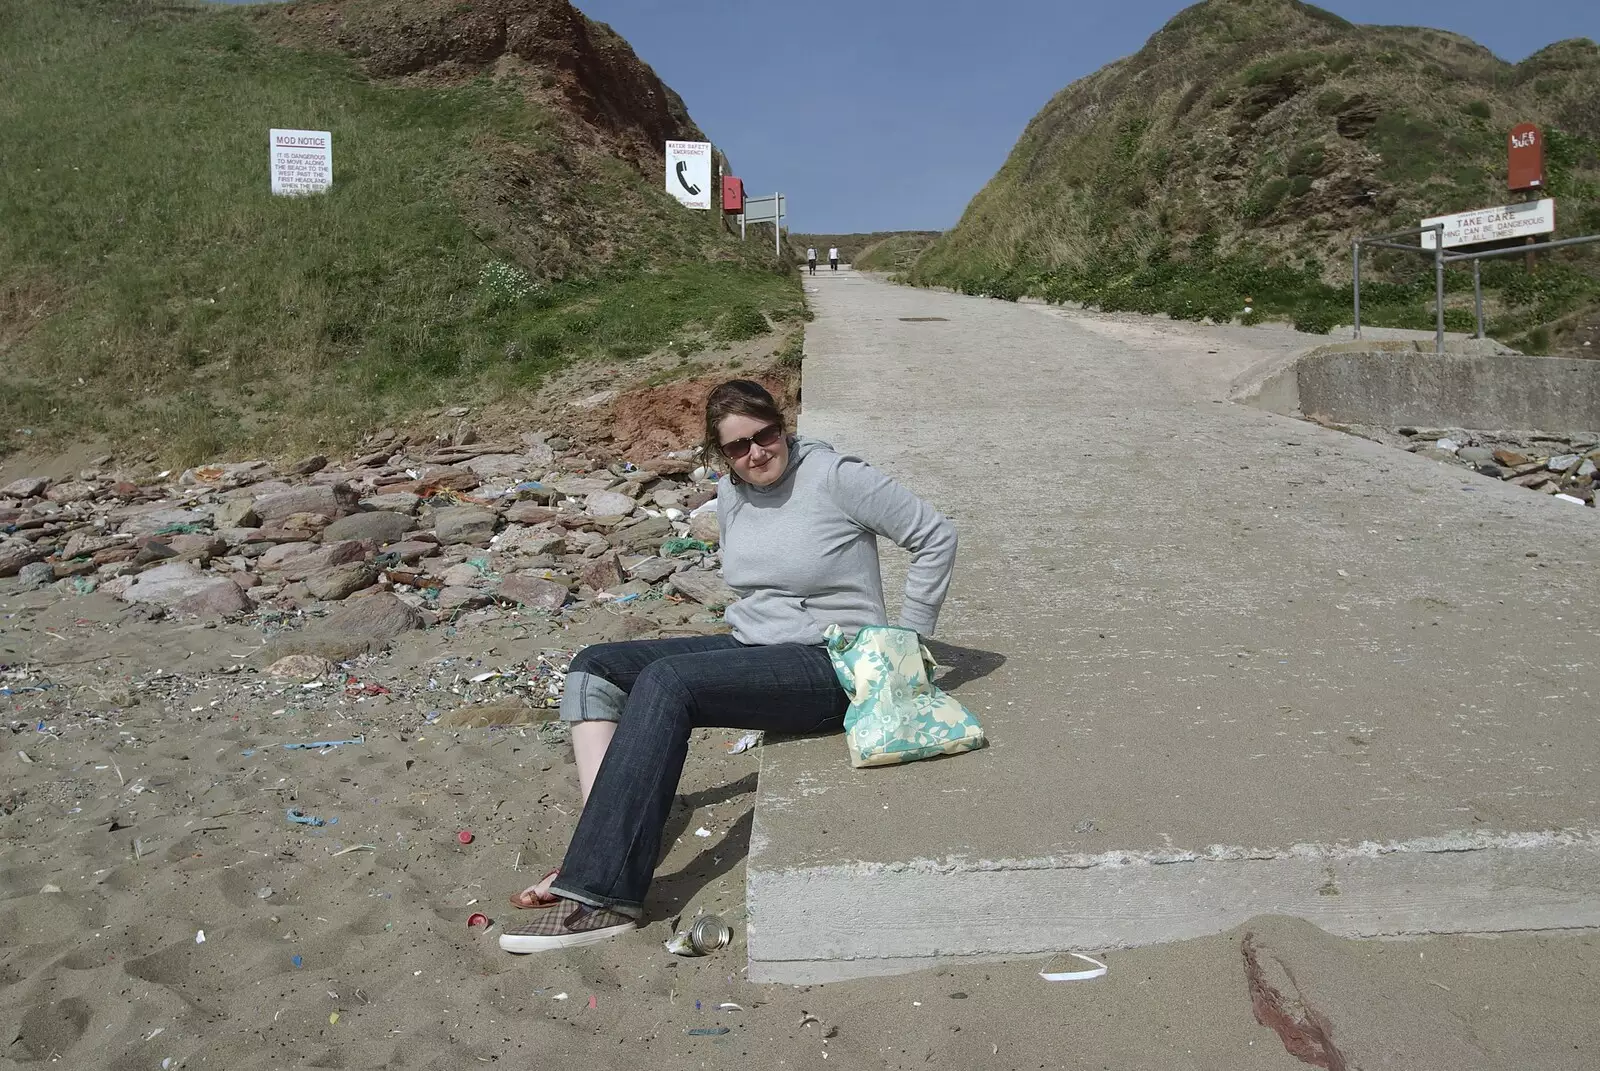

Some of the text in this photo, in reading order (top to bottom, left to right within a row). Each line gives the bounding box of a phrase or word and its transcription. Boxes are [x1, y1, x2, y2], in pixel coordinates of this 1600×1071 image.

[276, 136, 325, 145] MOD NOTICE
[1456, 217, 1484, 228] TAKE
[1488, 211, 1516, 223] CARE
[1430, 217, 1544, 241] BHING CAN BE DANGEROUS
[1458, 229, 1513, 243] AT ALL TIMES
